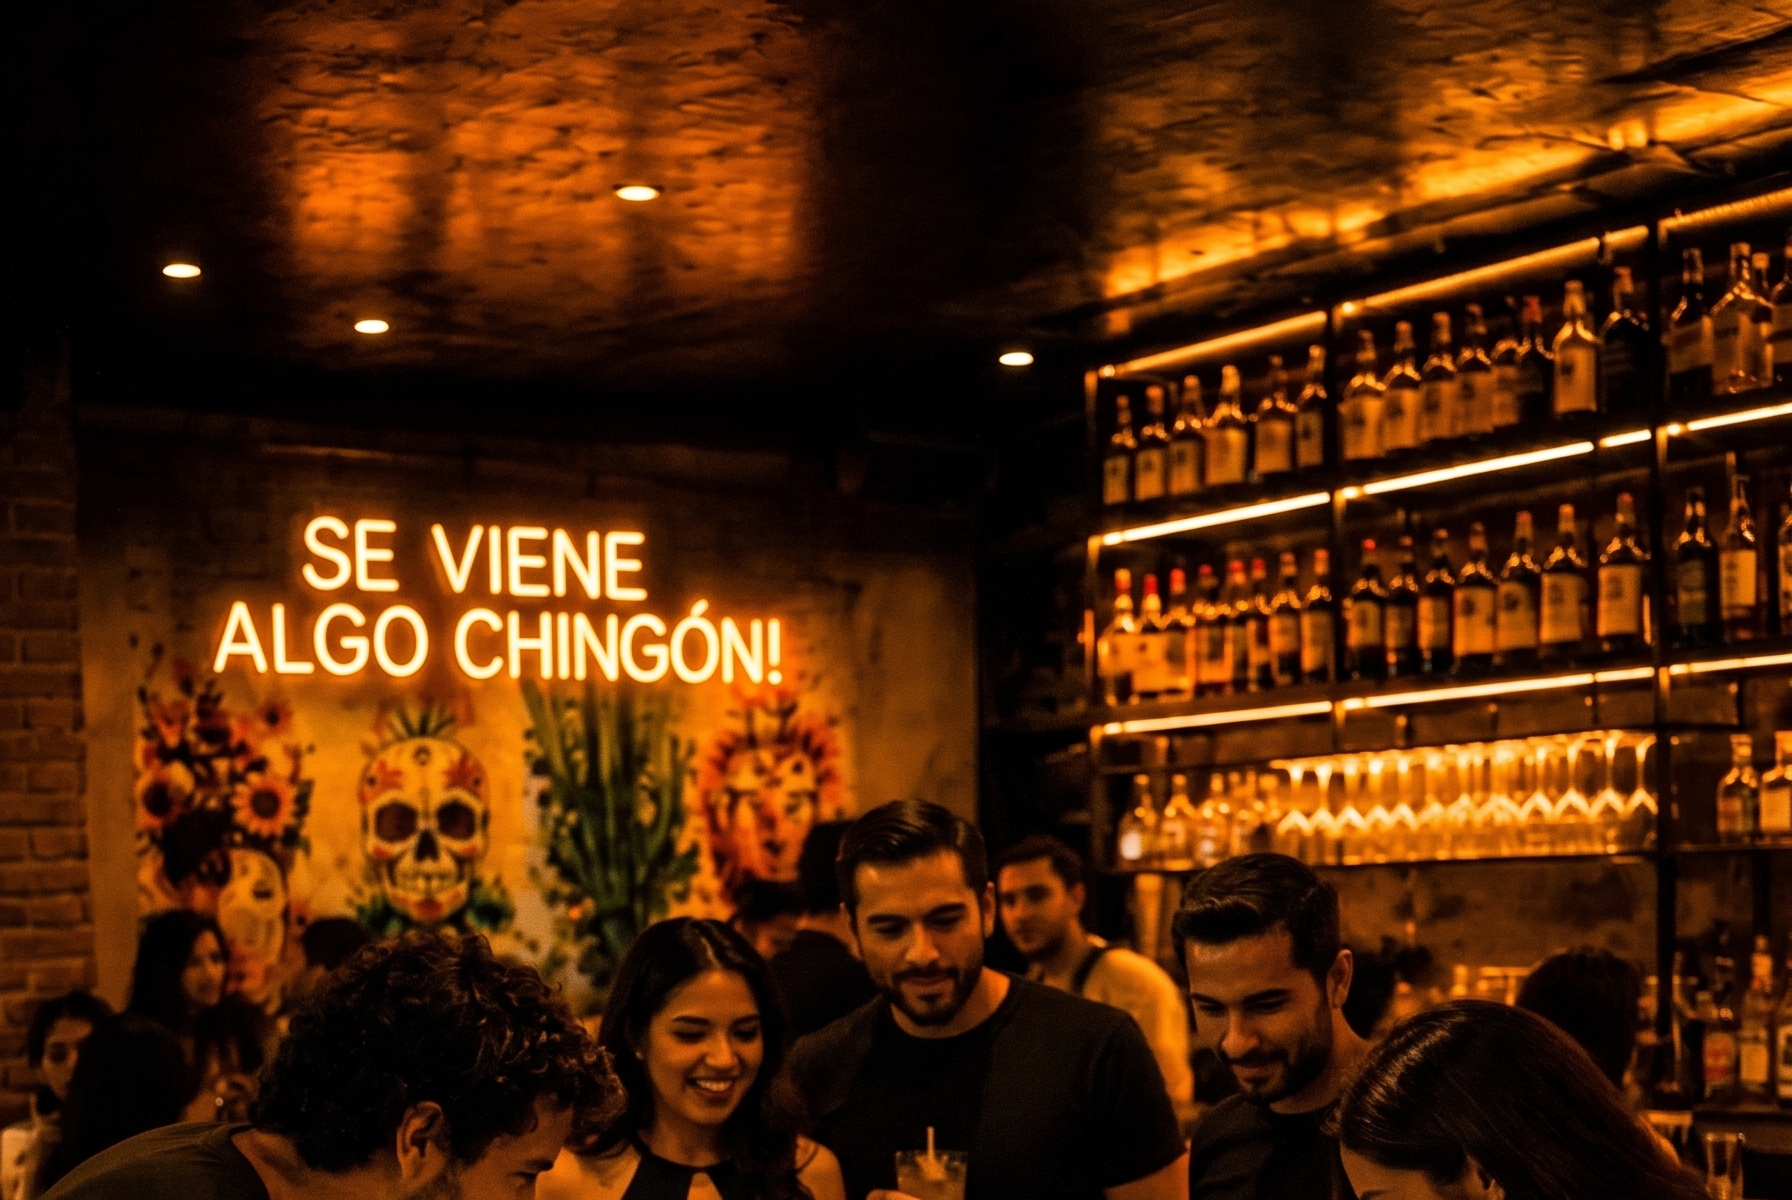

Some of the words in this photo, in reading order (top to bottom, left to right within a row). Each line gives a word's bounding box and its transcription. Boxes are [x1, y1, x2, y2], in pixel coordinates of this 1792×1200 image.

[302, 515, 399, 592] SE
[431, 524, 648, 601] VIENE
[212, 601, 430, 678] ALGO
[454, 599, 783, 685] CHINGÓN!
